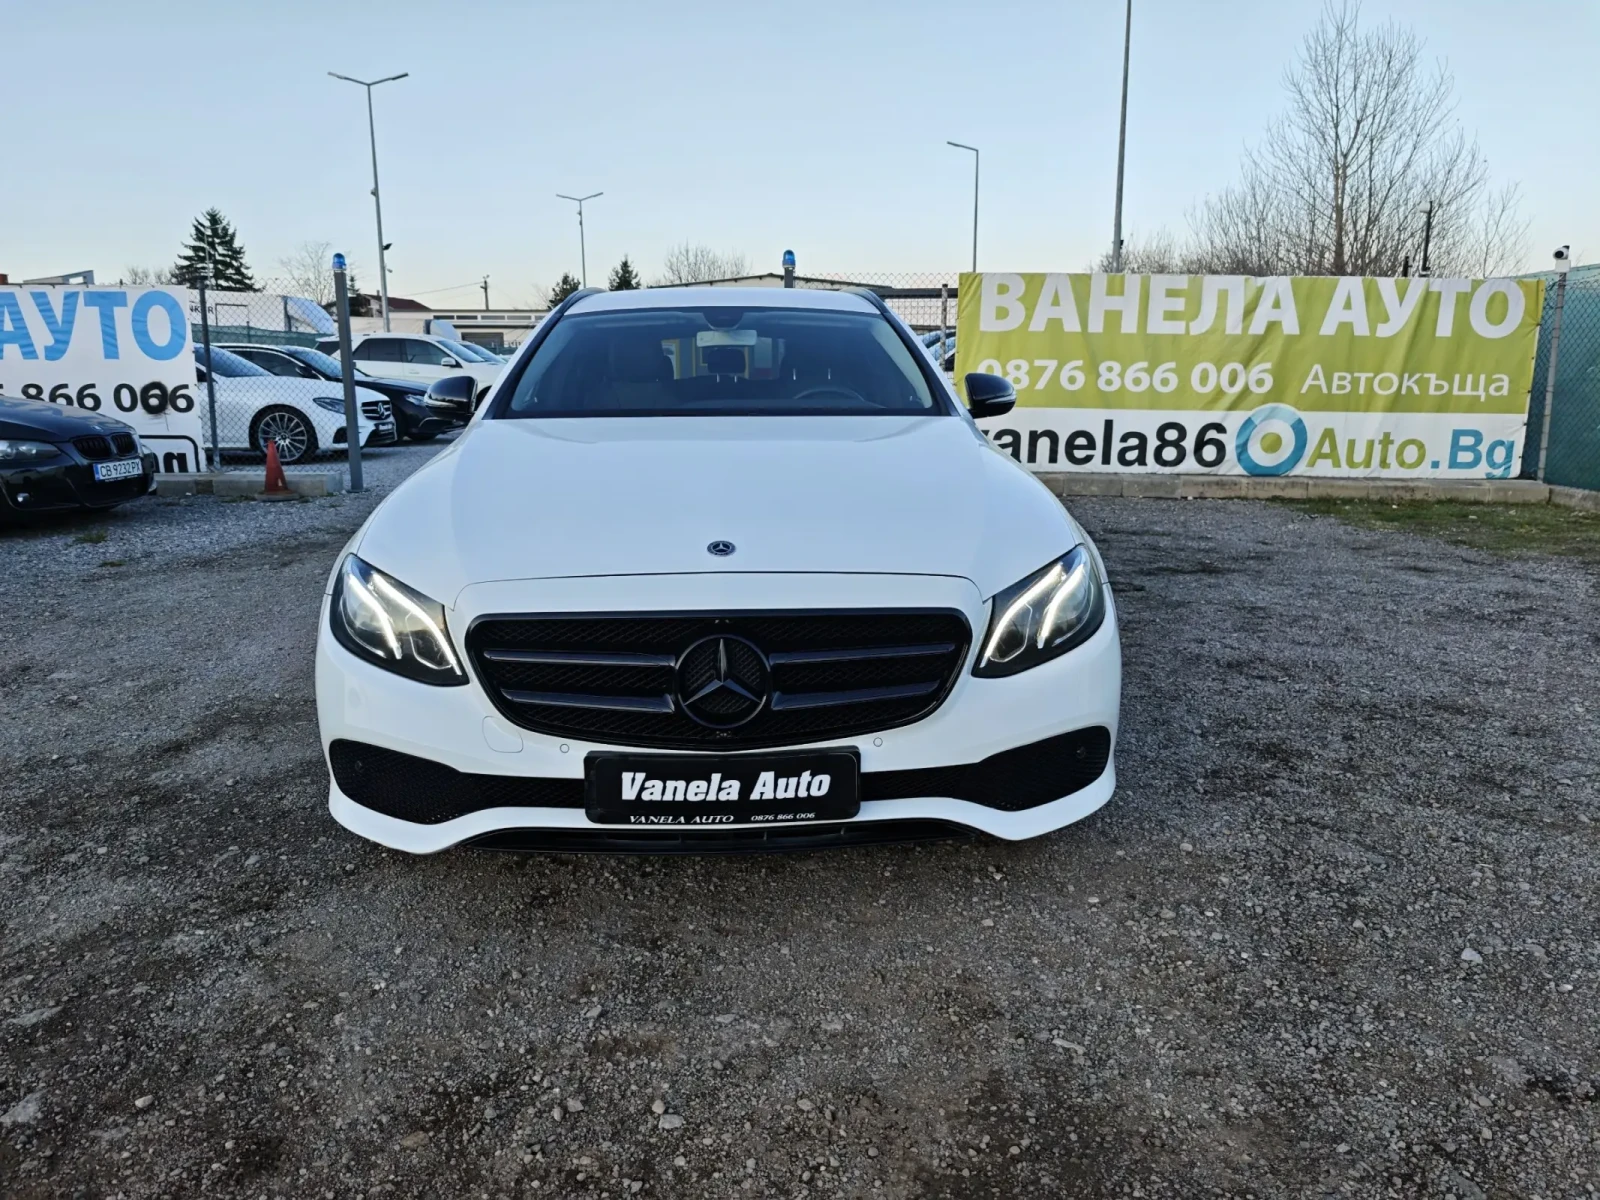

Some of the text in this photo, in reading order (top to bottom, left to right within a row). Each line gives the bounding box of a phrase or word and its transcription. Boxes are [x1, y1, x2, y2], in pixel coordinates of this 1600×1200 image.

[979, 273, 1526, 339] ВАНЕЛА АУТО
[1097, 361, 1178, 393] 866
[1190, 362, 1274, 394] 006
[1300, 363, 1509, 401] Автокъща
[982, 419, 1515, 479] anela86 Auto.Bg
[100, 465, 112, 477] CB
[622, 770, 831, 802] Vanela Auto
[629, 815, 685, 824] VANELA
[690, 814, 734, 823] AUTO
[776, 813, 794, 821] 866
